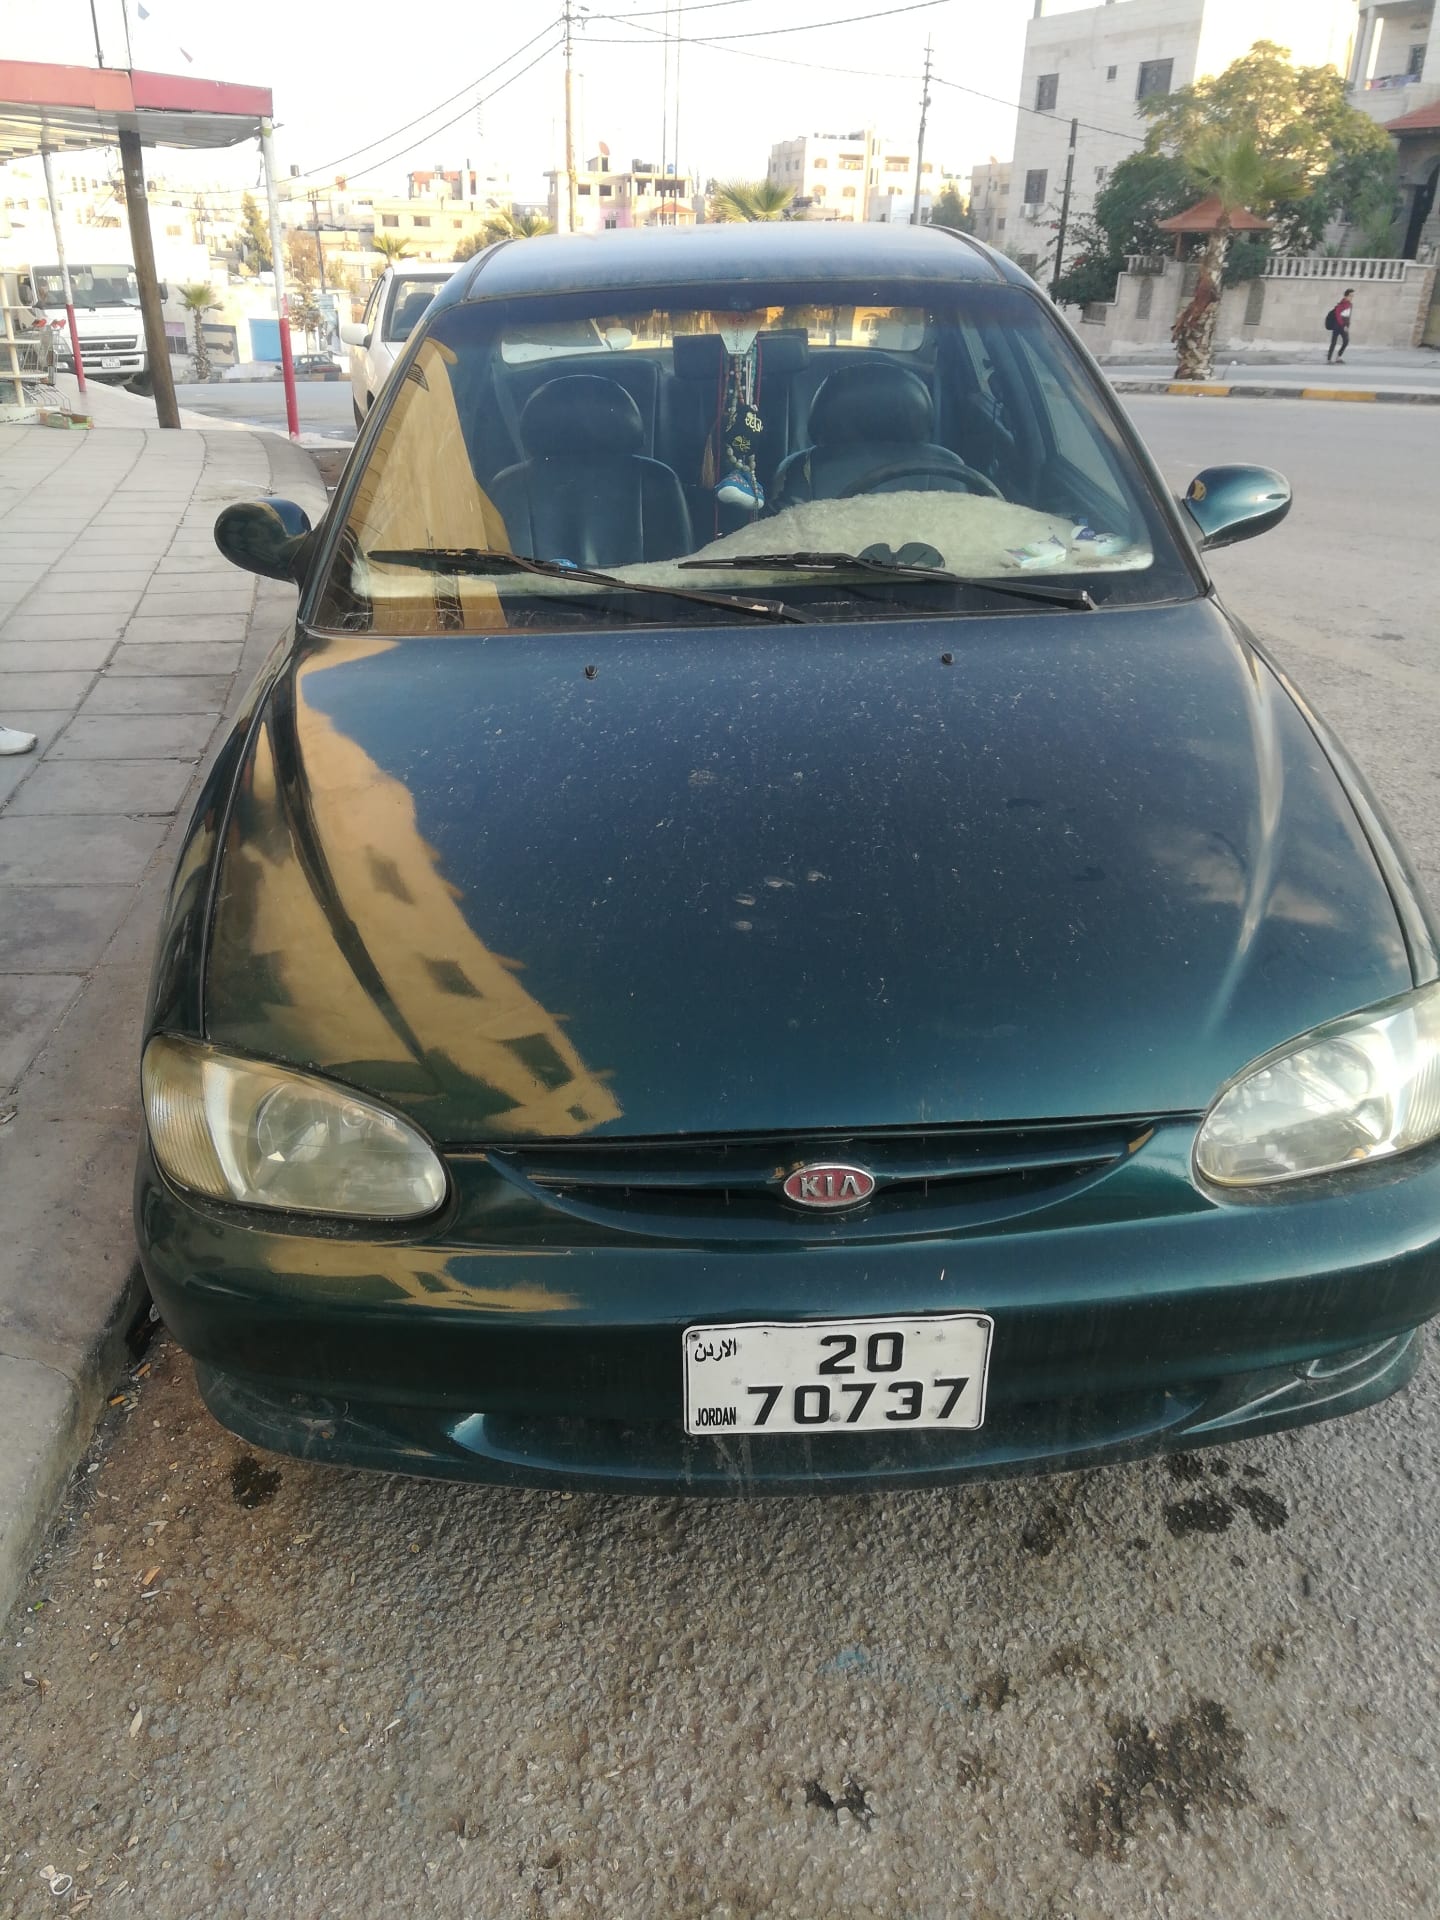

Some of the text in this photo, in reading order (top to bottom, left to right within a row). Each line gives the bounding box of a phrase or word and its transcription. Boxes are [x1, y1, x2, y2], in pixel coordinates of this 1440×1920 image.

[801, 1175, 862, 1198] KIA
[819, 1332, 904, 1375] 20
[695, 1407, 737, 1426] JORDAN
[747, 1377, 970, 1426] 70737
